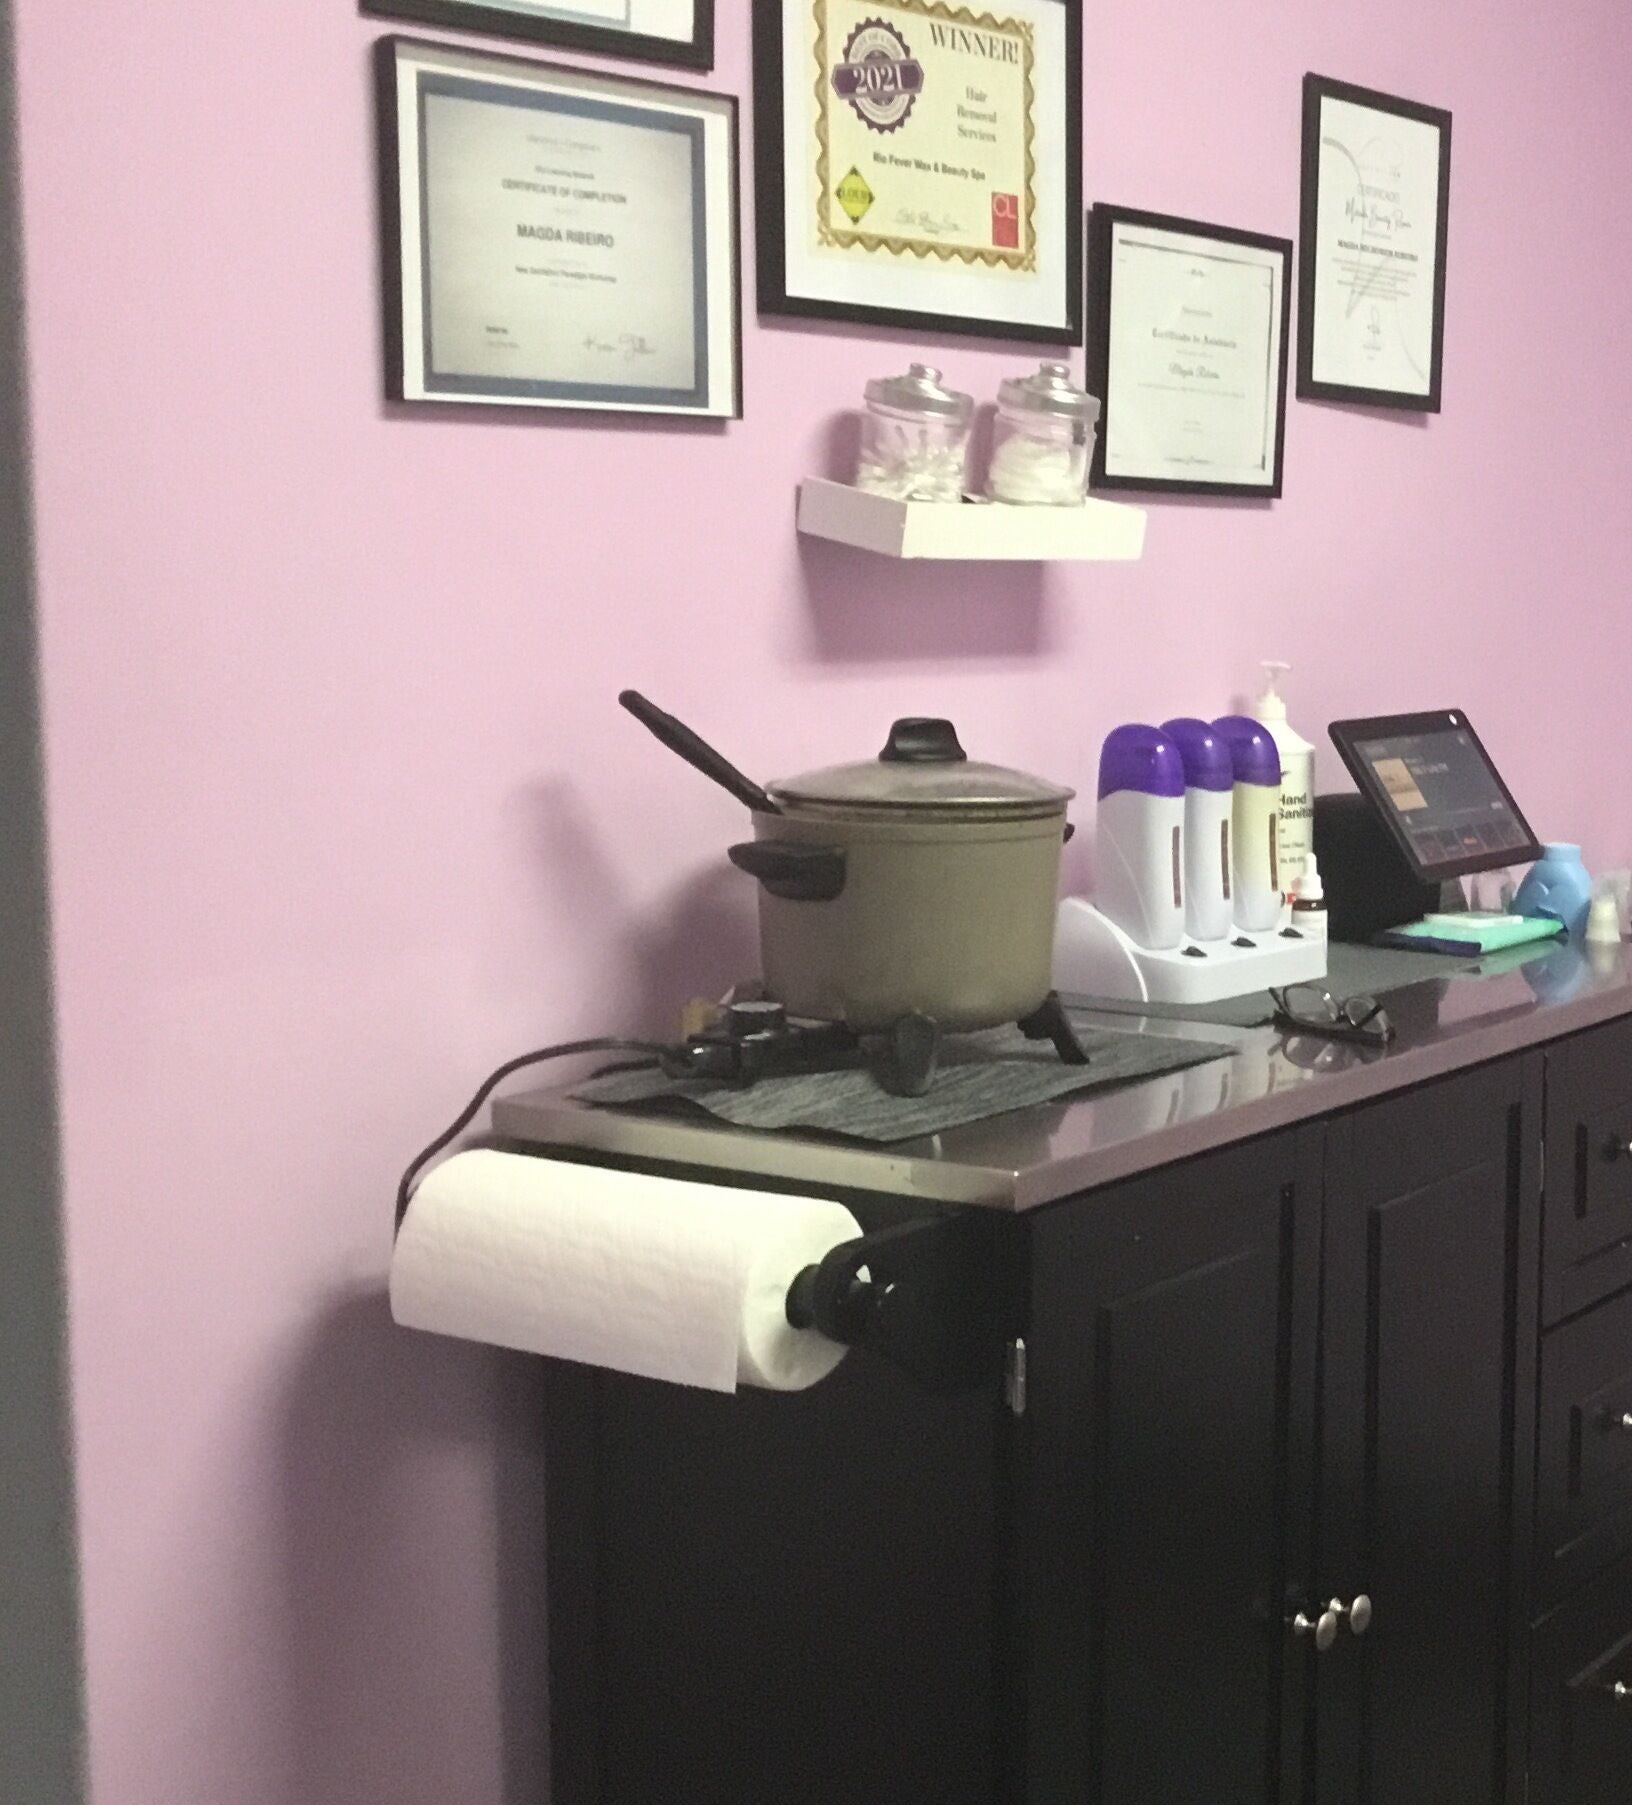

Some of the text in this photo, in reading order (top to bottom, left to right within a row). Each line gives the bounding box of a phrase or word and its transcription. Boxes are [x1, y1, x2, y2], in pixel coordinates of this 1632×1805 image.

[930, 22, 1018, 65] WINNER!
[852, 63, 903, 94] 2021
[965, 86, 988, 102] Hair
[957, 104, 997, 124] Removal
[957, 125, 997, 142] Services
[889, 154, 912, 168] Fever
[941, 162, 968, 179] Beauty
[970, 167, 985, 181] Spa
[993, 193, 1018, 220] CL
[516, 223, 614, 249] MAGDA RIBEIRO
[1279, 792, 1307, 806] Hand
